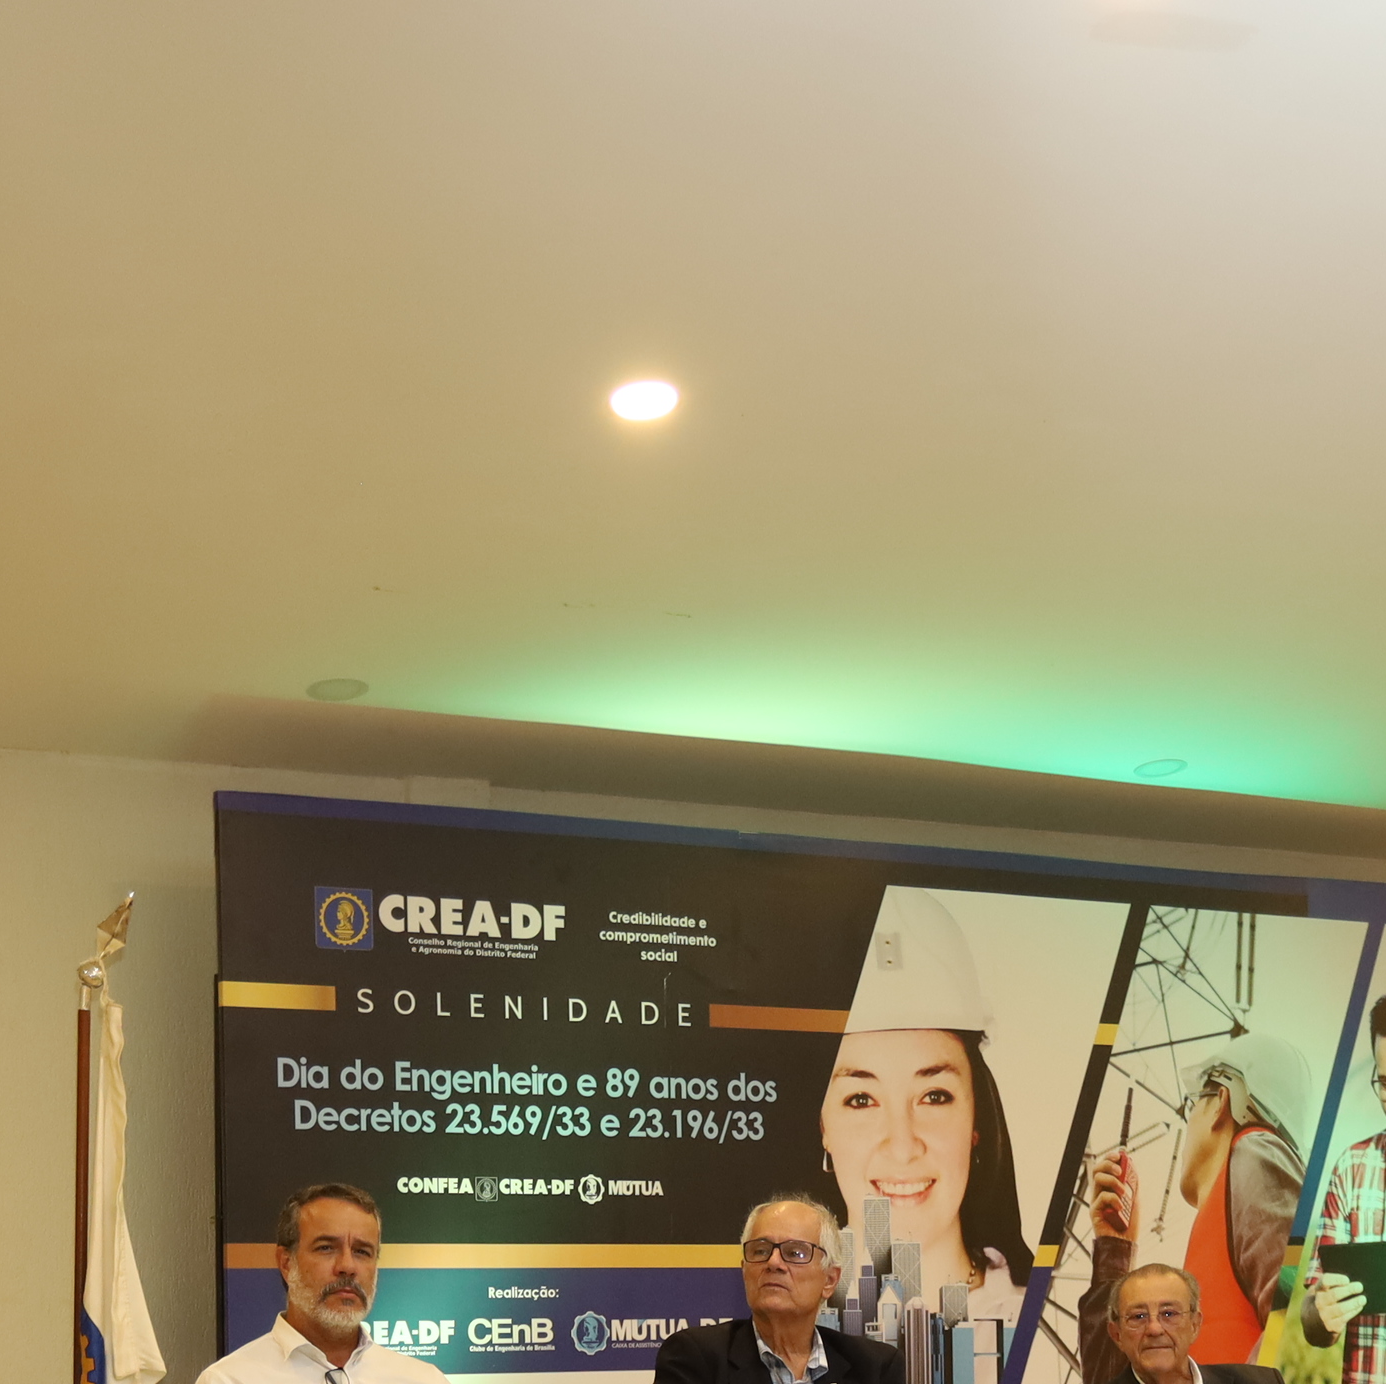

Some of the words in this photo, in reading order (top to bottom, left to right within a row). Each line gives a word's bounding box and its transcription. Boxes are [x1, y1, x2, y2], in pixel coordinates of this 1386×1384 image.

[379, 894, 565, 941] CREA-DF
[609, 911, 696, 929] Credibilidade
[698, 918, 707, 929] e
[408, 937, 445, 946] Conselho
[447, 940, 481, 949] Regional
[483, 941, 493, 949] de
[495, 942, 538, 952] Engenharia
[599, 929, 717, 948] comprometimento
[418, 946, 462, 955] Agronomia
[464, 948, 474, 956] do
[476, 949, 505, 958] Distrito
[507, 951, 536, 959] Federal
[641, 949, 678, 963] social
[356, 988, 692, 1027] SOLENIDADE
[277, 1056, 329, 1090] Dia
[340, 1060, 383, 1092] do
[394, 1061, 567, 1103] Engenheiro
[576, 1072, 596, 1096] e
[605, 1068, 640, 1098] 89
[649, 1076, 719, 1102] anos
[727, 1074, 777, 1103] dos
[294, 1099, 436, 1136] Decretos
[445, 1104, 591, 1139] 23.569/33
[600, 1116, 620, 1139] e
[628, 1109, 765, 1144] 23.196/33
[397, 1177, 474, 1195] CONFEA
[499, 1178, 574, 1195] CREA-DF
[488, 1286, 559, 1300] Realização:
[360, 1320, 455, 1345] EA-DF
[468, 1318, 554, 1345] CEnB
